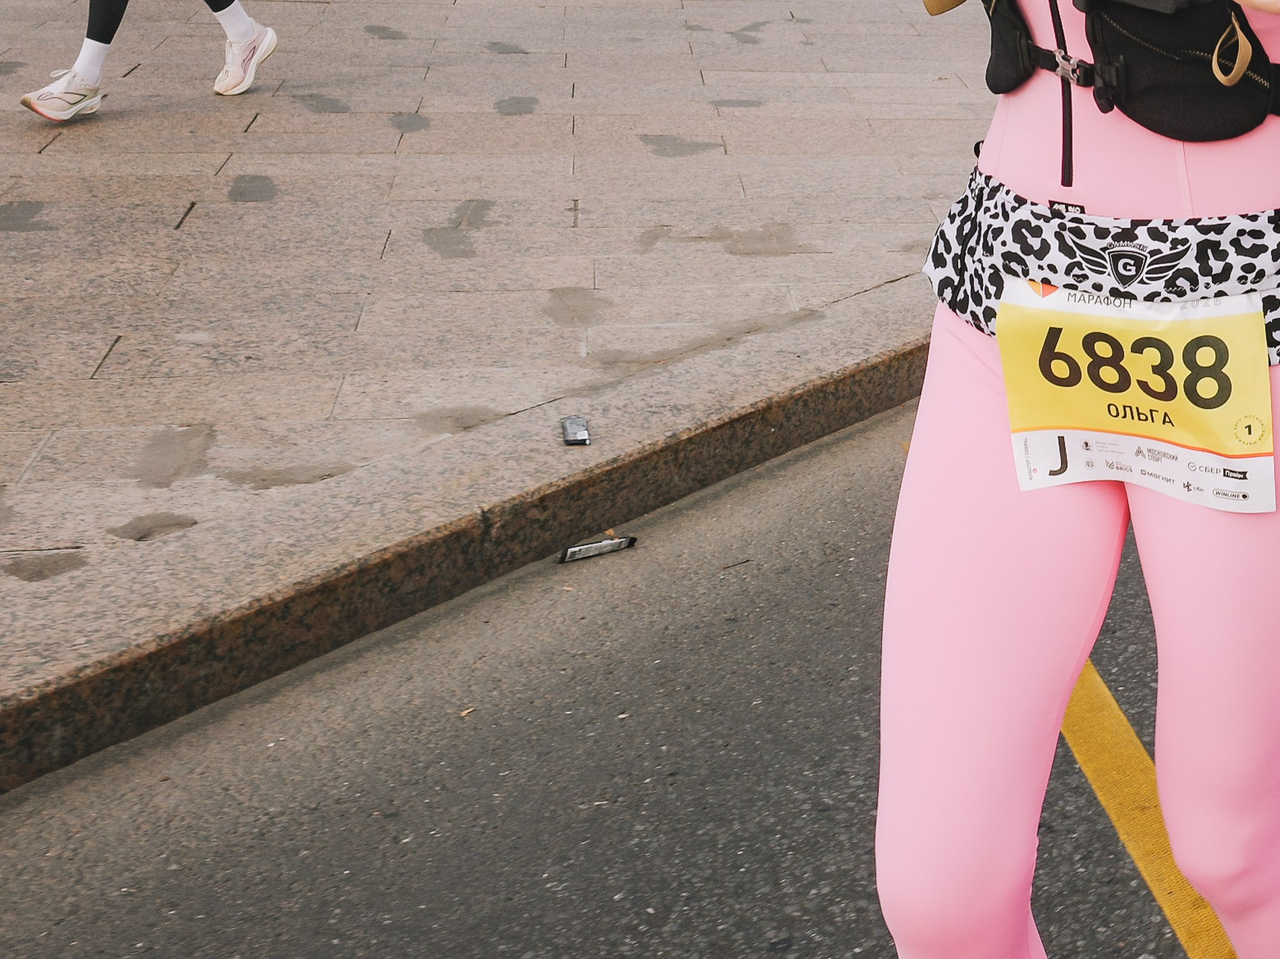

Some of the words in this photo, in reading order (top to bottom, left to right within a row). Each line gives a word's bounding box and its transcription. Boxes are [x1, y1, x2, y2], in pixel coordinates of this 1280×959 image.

[1117, 258, 1136, 276] G
[1067, 292, 1132, 309] МАРАФОН
[1038, 326, 1232, 410] 6838
[1107, 403, 1175, 427] ОЛЬГА
[1244, 424, 1252, 435] 1
[1048, 435, 1069, 476] J
[1198, 465, 1221, 474] СБЕР
[1215, 490, 1240, 499] WINLINE
